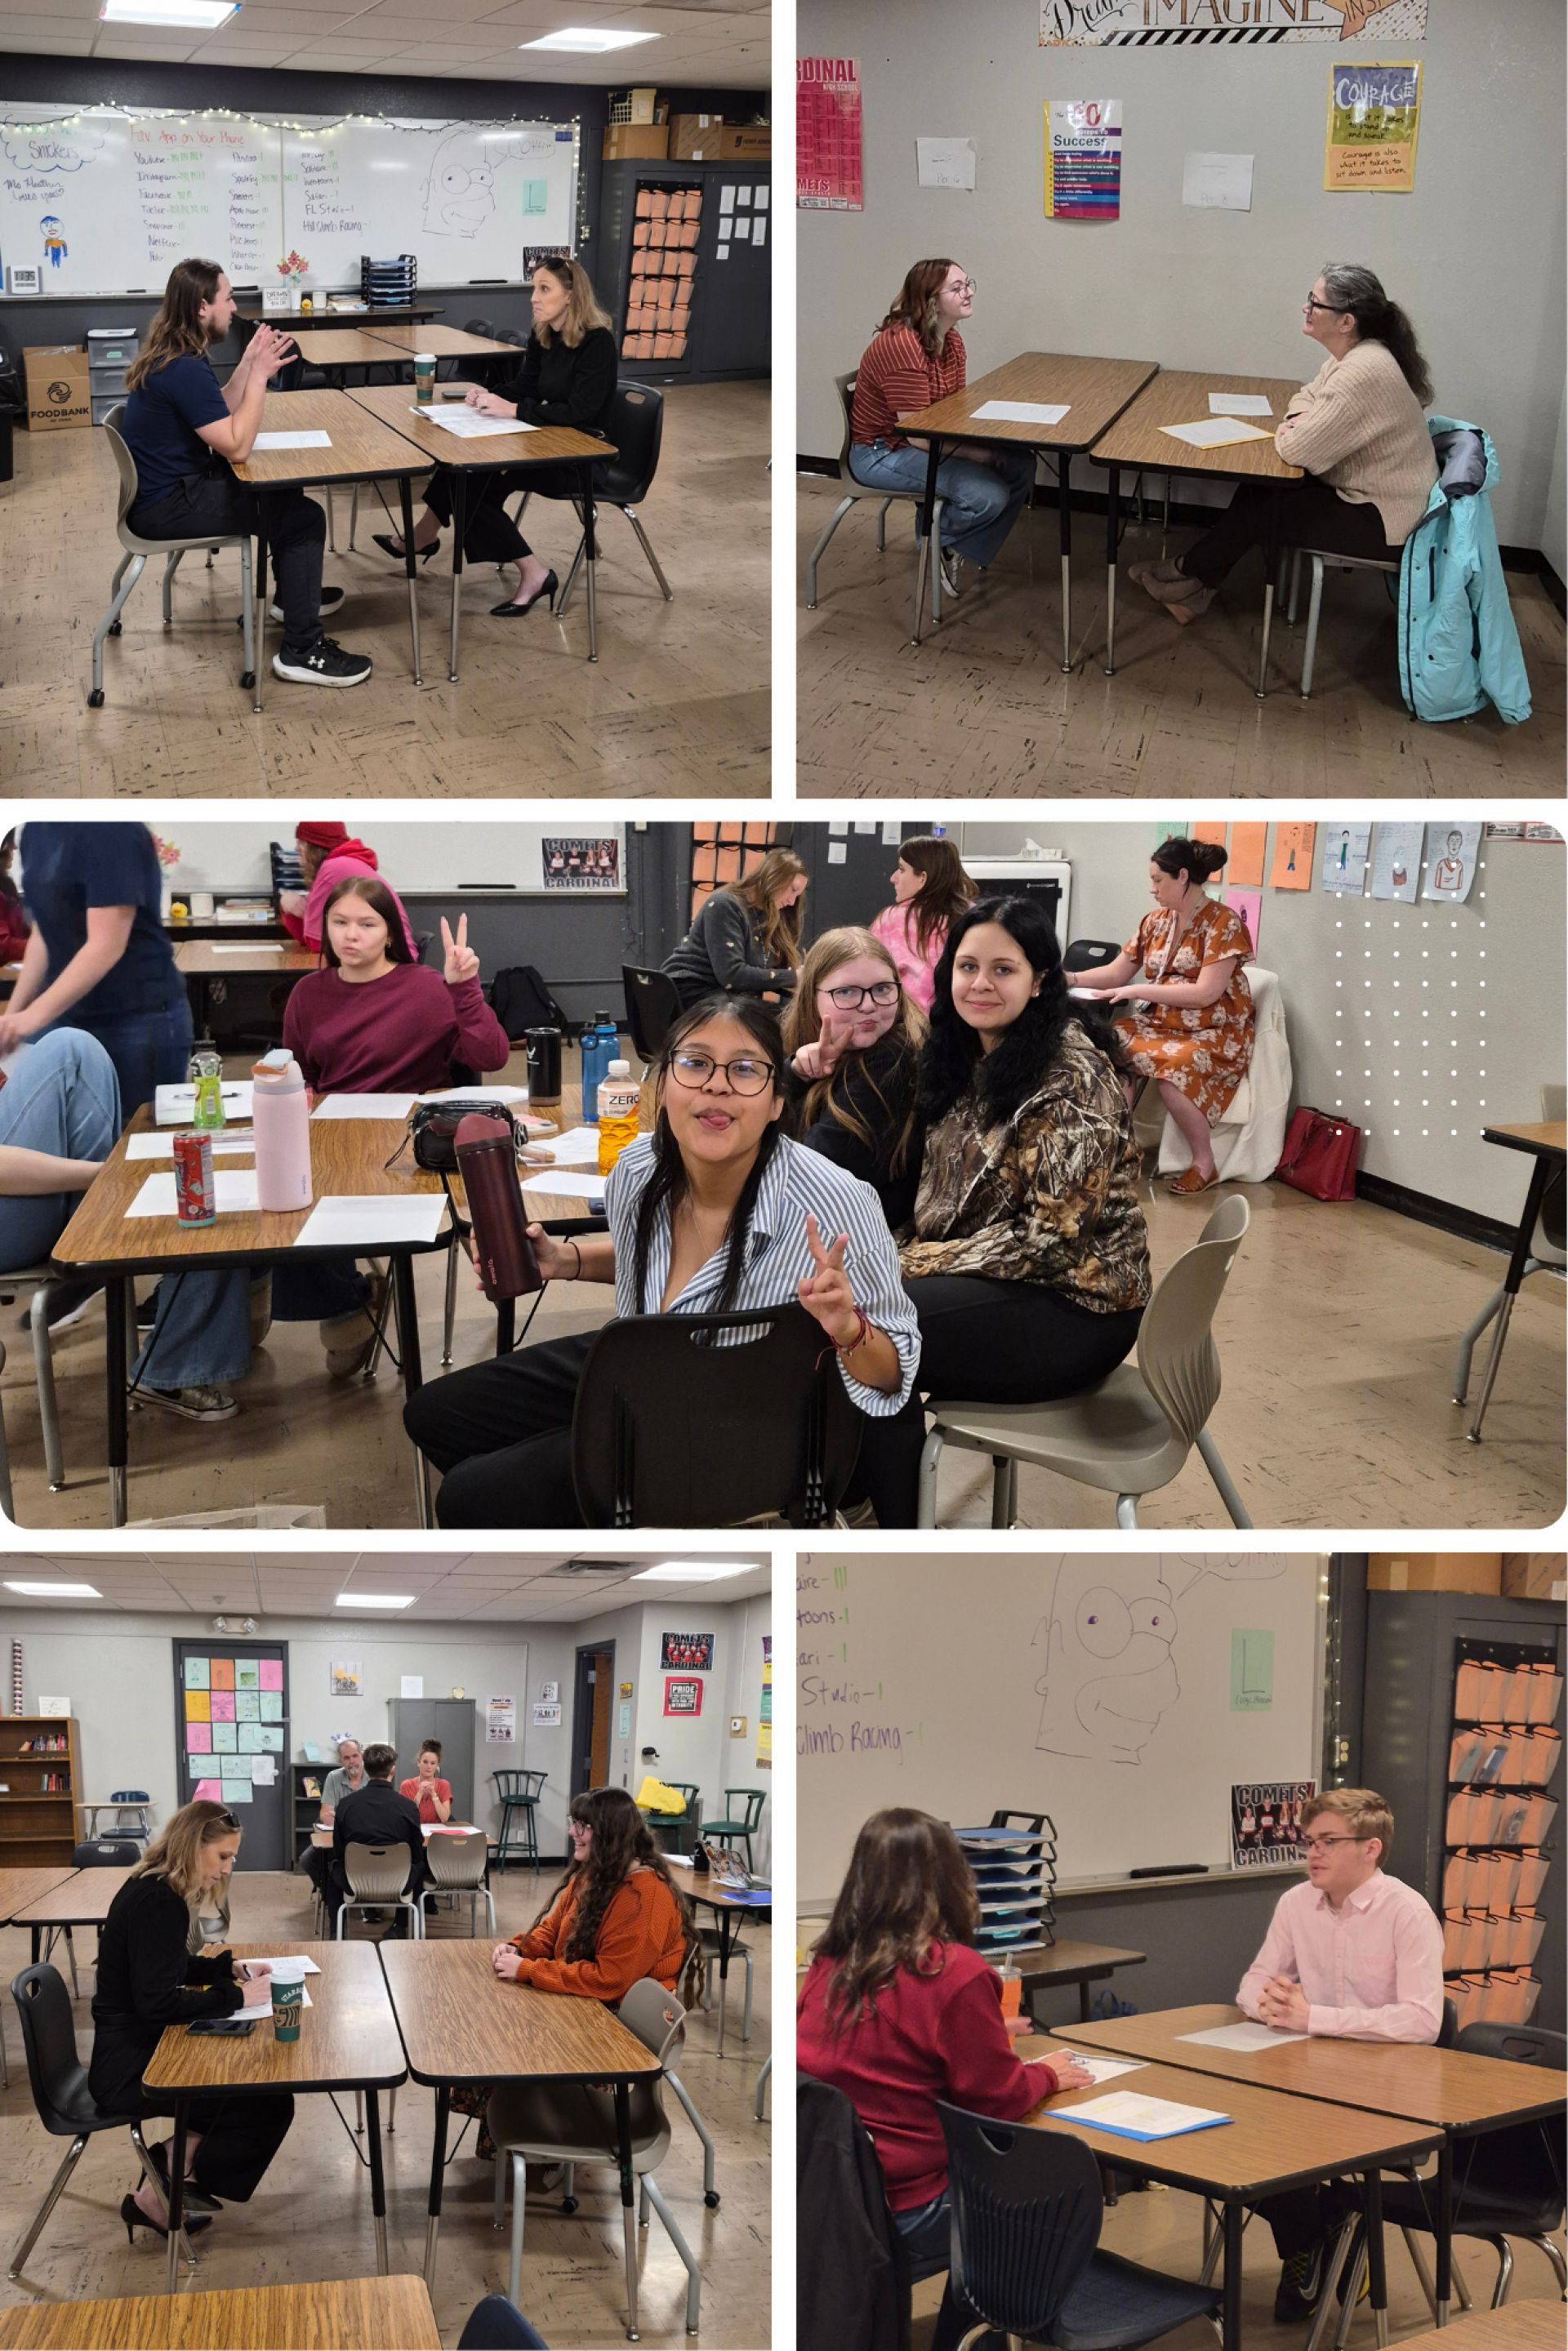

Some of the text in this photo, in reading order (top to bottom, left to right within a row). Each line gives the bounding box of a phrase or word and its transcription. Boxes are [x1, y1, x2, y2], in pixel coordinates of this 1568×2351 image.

[1336, 78, 1414, 109] COURAGE
[158, 130, 177, 144] App
[181, 133, 194, 144] on
[197, 130, 216, 144] Your
[219, 130, 244, 144] Phone
[1054, 135, 1107, 147] Success
[29, 140, 79, 159] Snickers
[1342, 151, 1373, 160] Courage
[1383, 148, 1399, 156] also
[1340, 161, 1356, 169] what
[1369, 159, 1389, 167] takes
[1336, 171, 1345, 179] sit
[31, 407, 90, 419] FOODBANK
[548, 839, 612, 853] COMETS
[545, 876, 618, 889] CARDINAL
[665, 1633, 710, 1644] COMETS
[796, 1650, 820, 1667] ari
[661, 1661, 710, 1670] CARDINAL
[1241, 1638, 1266, 1694] L
[672, 1685, 696, 1694] PRIDE
[801, 1676, 860, 1706] Studio
[796, 1721, 904, 1766] Climb Racing
[1238, 1784, 1309, 1806] COMETS
